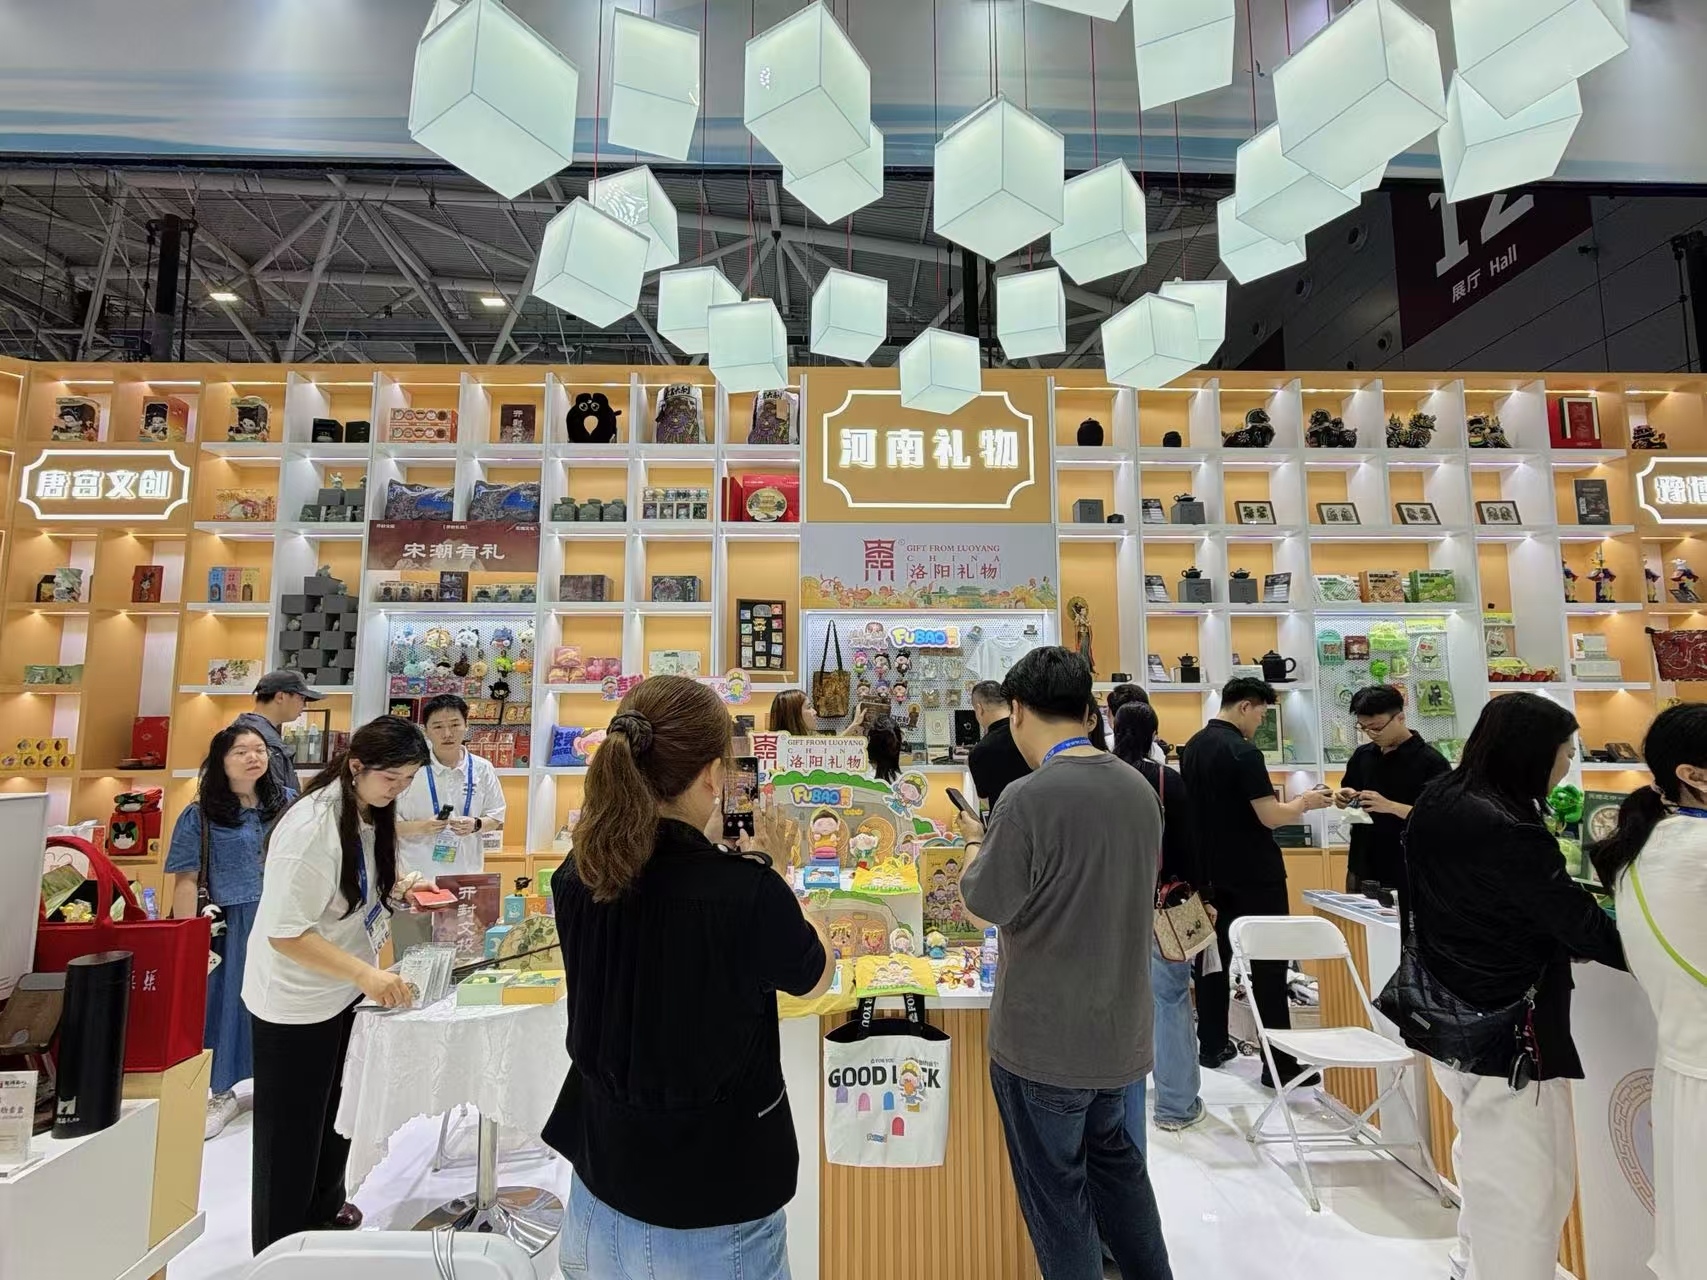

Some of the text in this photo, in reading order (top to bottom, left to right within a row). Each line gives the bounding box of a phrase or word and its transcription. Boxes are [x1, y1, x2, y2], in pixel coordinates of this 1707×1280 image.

[1452, 243, 1517, 303] 展厅 Hall
[839, 428, 1019, 469] 河南礼物
[36, 470, 172, 499] 唐宫文创
[402, 542, 505, 560] 宋潮有礼
[906, 544, 1000, 552] GIFT FROM LUOYANG
[910, 563, 997, 579] 洛阳礼物
[891, 627, 946, 646] FUBAO
[790, 755, 861, 769] 洛阳礼物
[792, 785, 841, 804] FUBAO
[457, 886, 477, 953] 开封文投
[861, 1007, 872, 1028] YOU
[829, 1066, 887, 1088] GOOD
